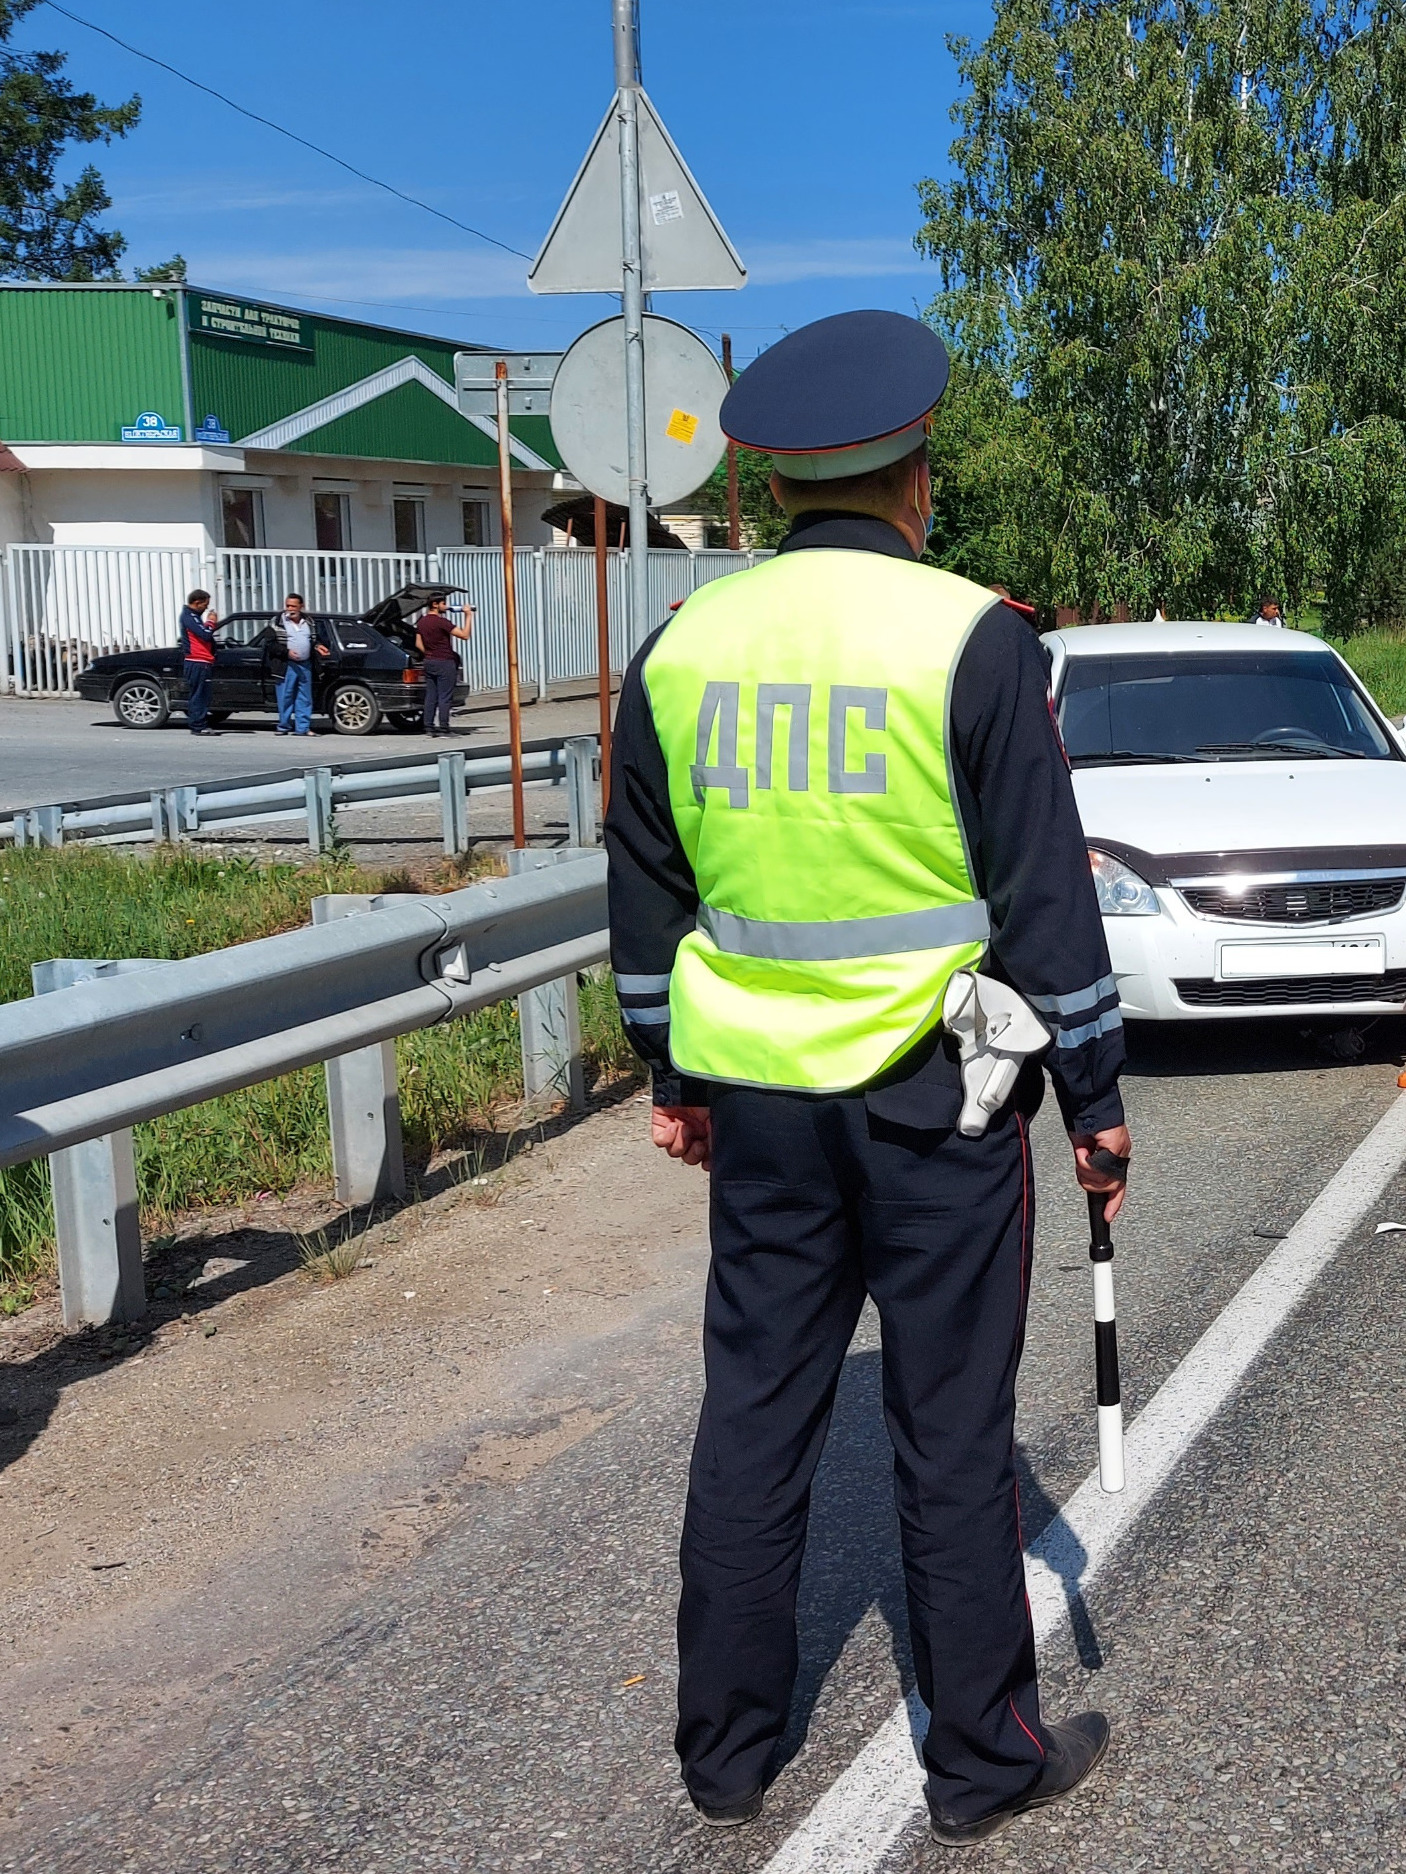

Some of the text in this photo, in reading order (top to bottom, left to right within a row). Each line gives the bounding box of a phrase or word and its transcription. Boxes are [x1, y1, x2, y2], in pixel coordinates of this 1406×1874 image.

[201, 300, 241, 317] ЗАПЧАСТИ
[142, 416, 158, 427] 38
[689, 681, 887, 809] ДПС
